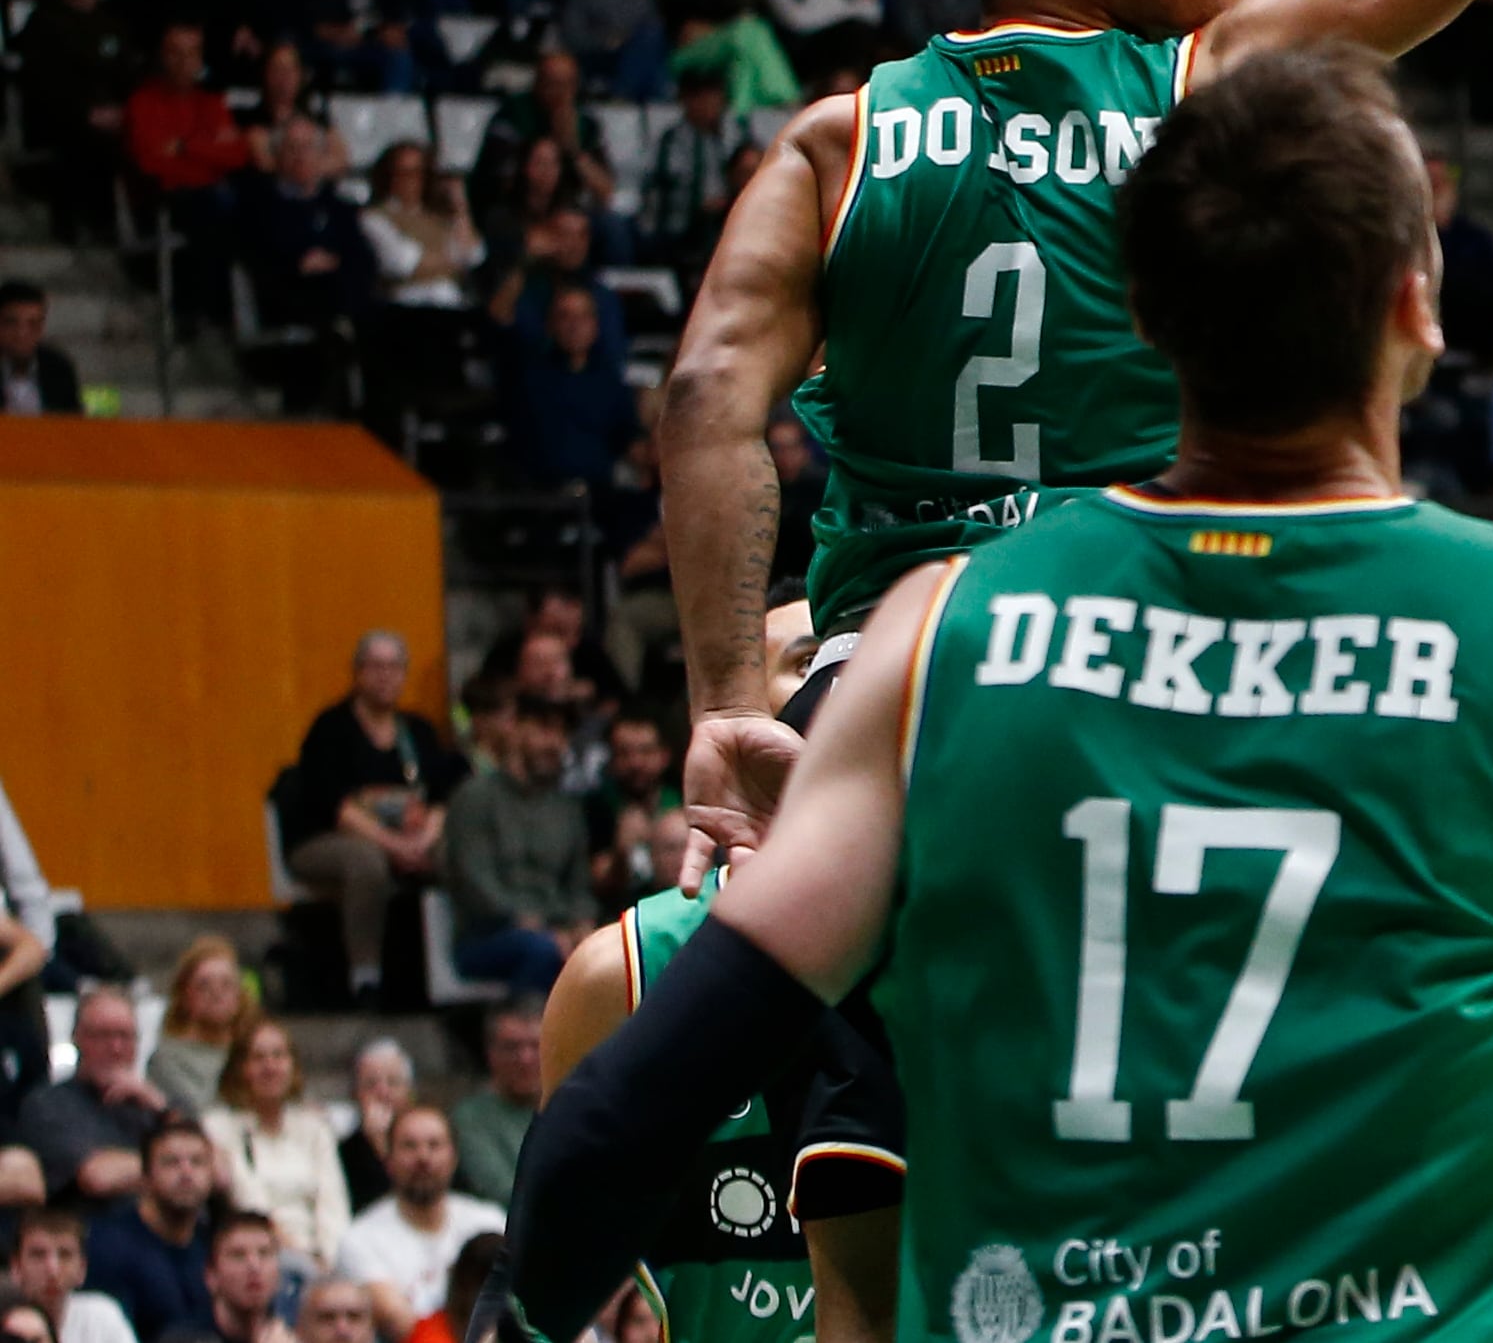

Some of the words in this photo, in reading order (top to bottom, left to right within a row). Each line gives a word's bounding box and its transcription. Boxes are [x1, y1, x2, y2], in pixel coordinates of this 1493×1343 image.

[872, 96, 1163, 185] DOSON
[952, 241, 1046, 484] 2
[975, 591, 1460, 722] DEKKER
[1052, 797, 1341, 1142] 17
[1050, 1264, 1440, 1343] BADALONA
[1053, 1238, 1152, 1291] City
[1166, 1228, 1222, 1279] of
